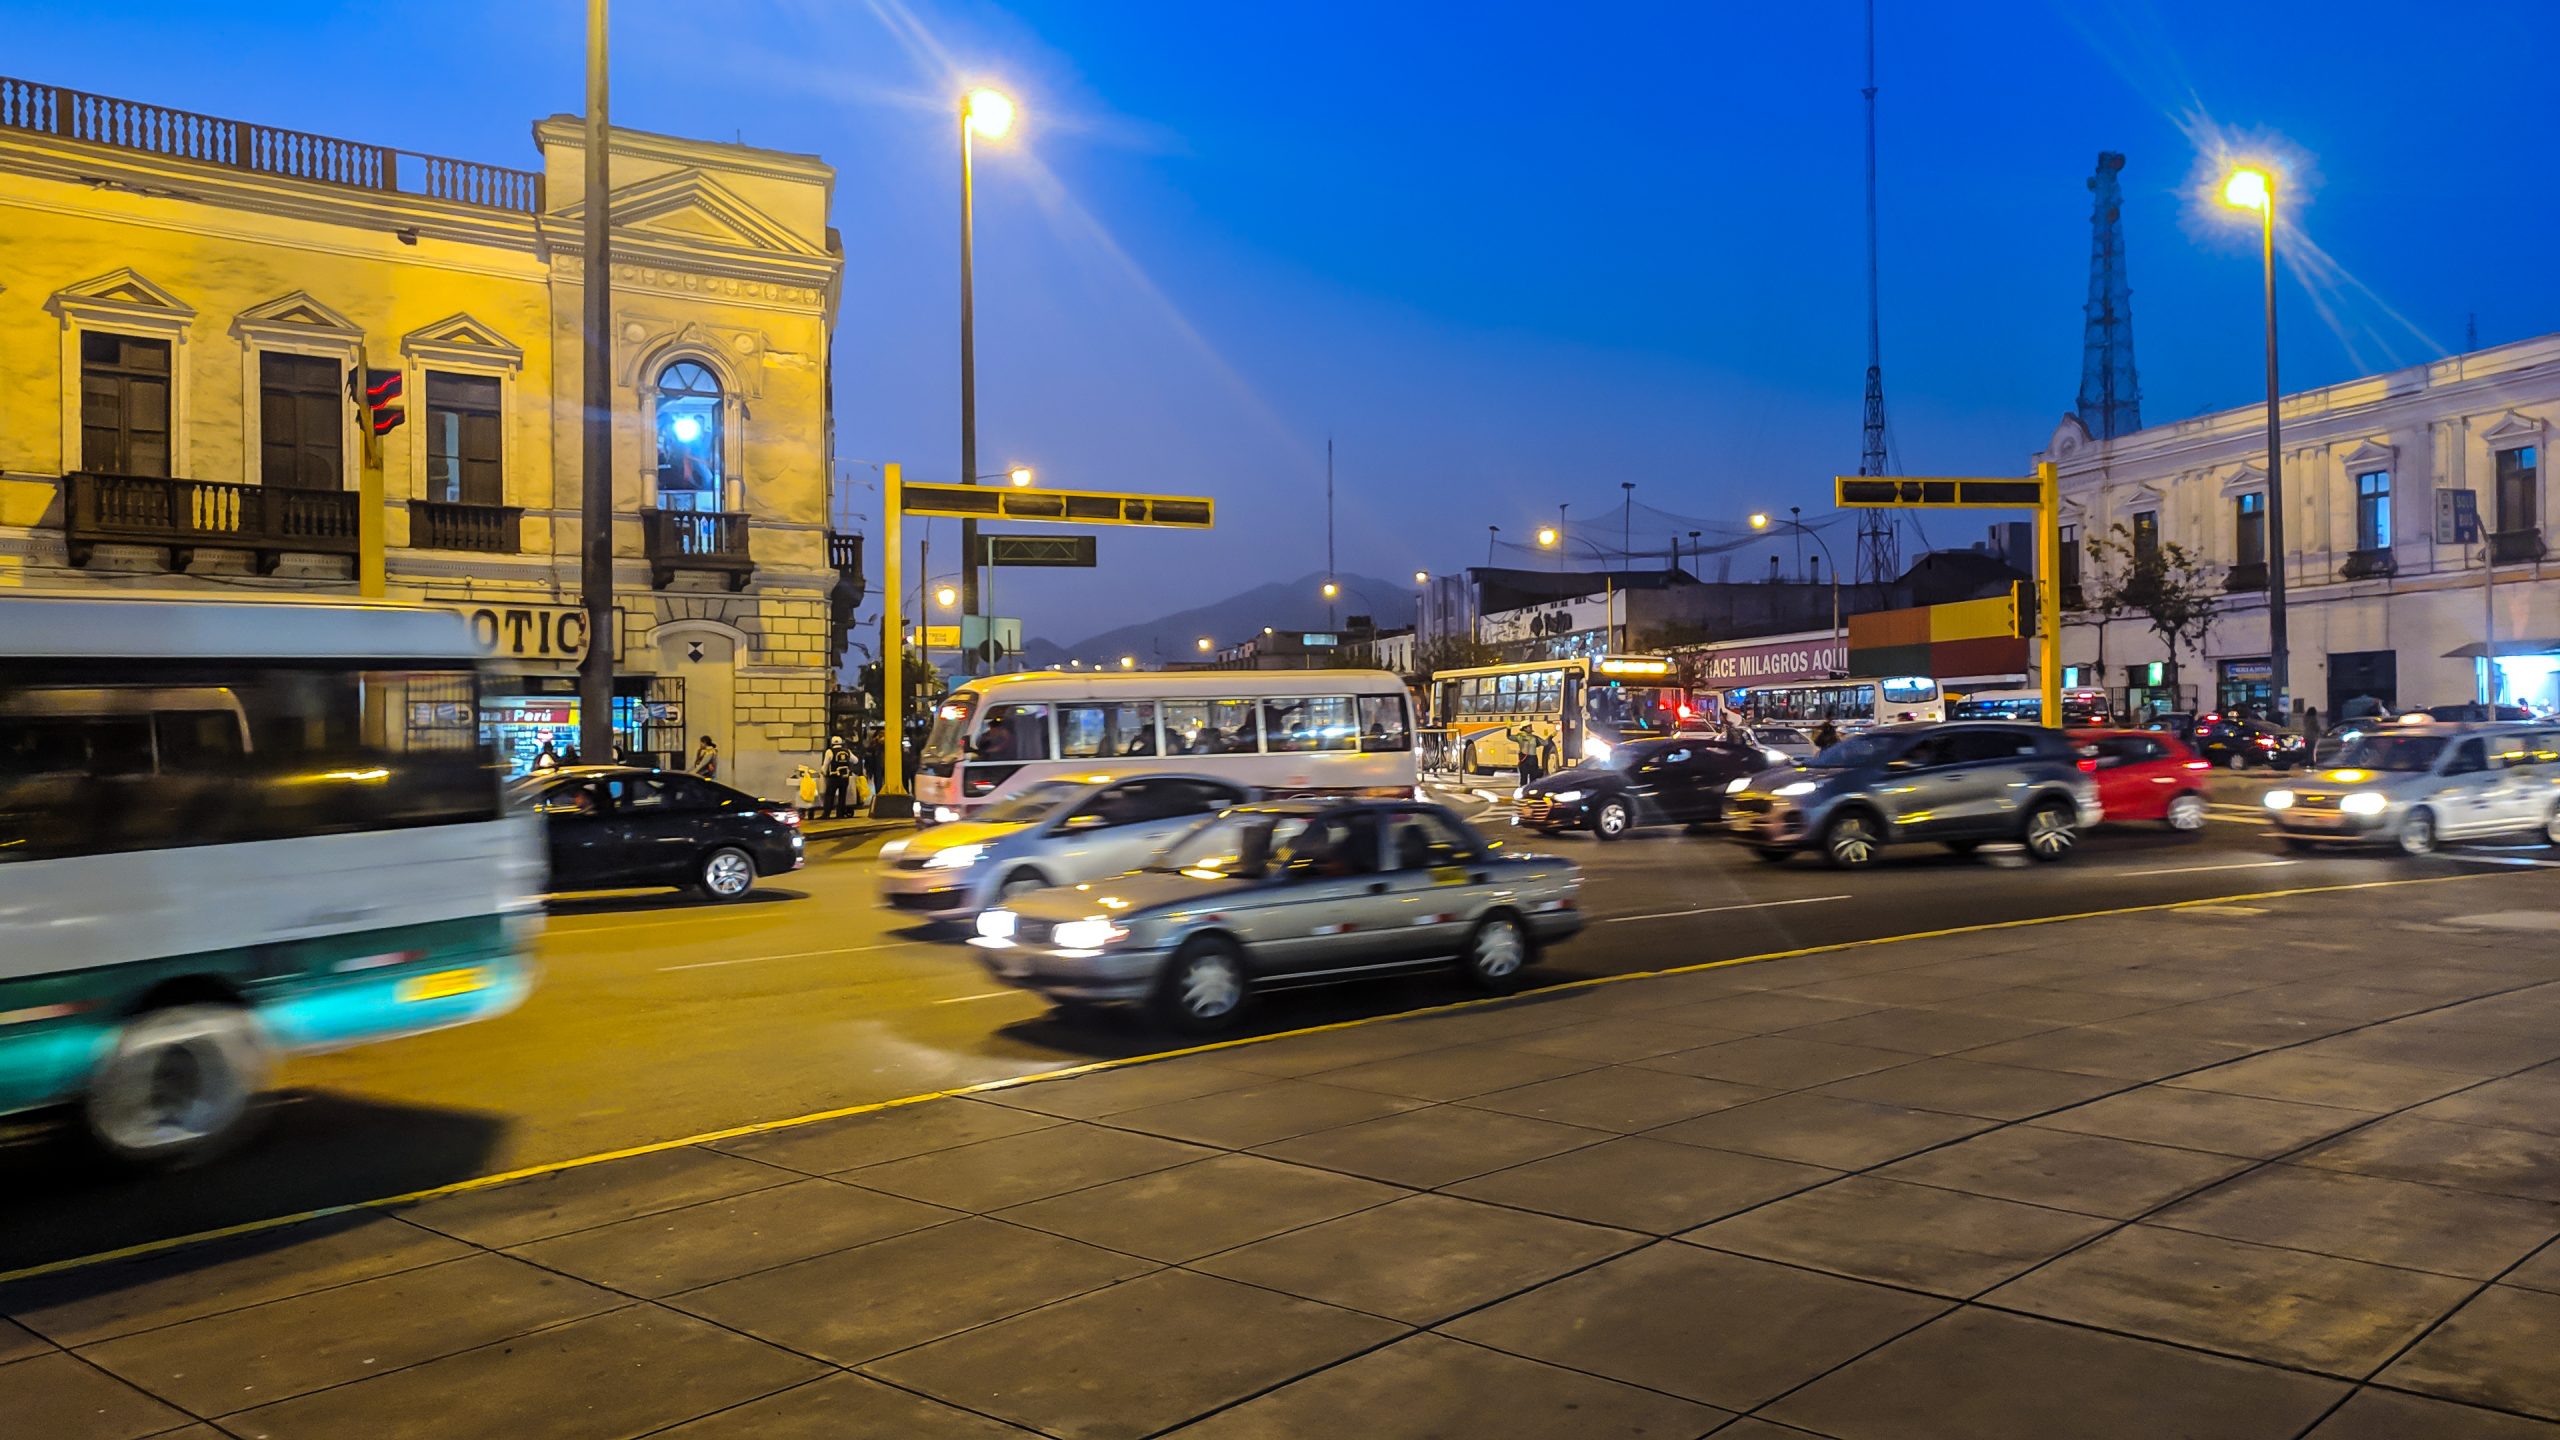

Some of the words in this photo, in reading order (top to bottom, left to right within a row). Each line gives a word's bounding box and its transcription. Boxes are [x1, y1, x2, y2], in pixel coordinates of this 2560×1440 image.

[471, 608, 581, 653] OTIC
[1739, 651, 1809, 676] MILAGROS
[513, 709, 552, 722] Perú
